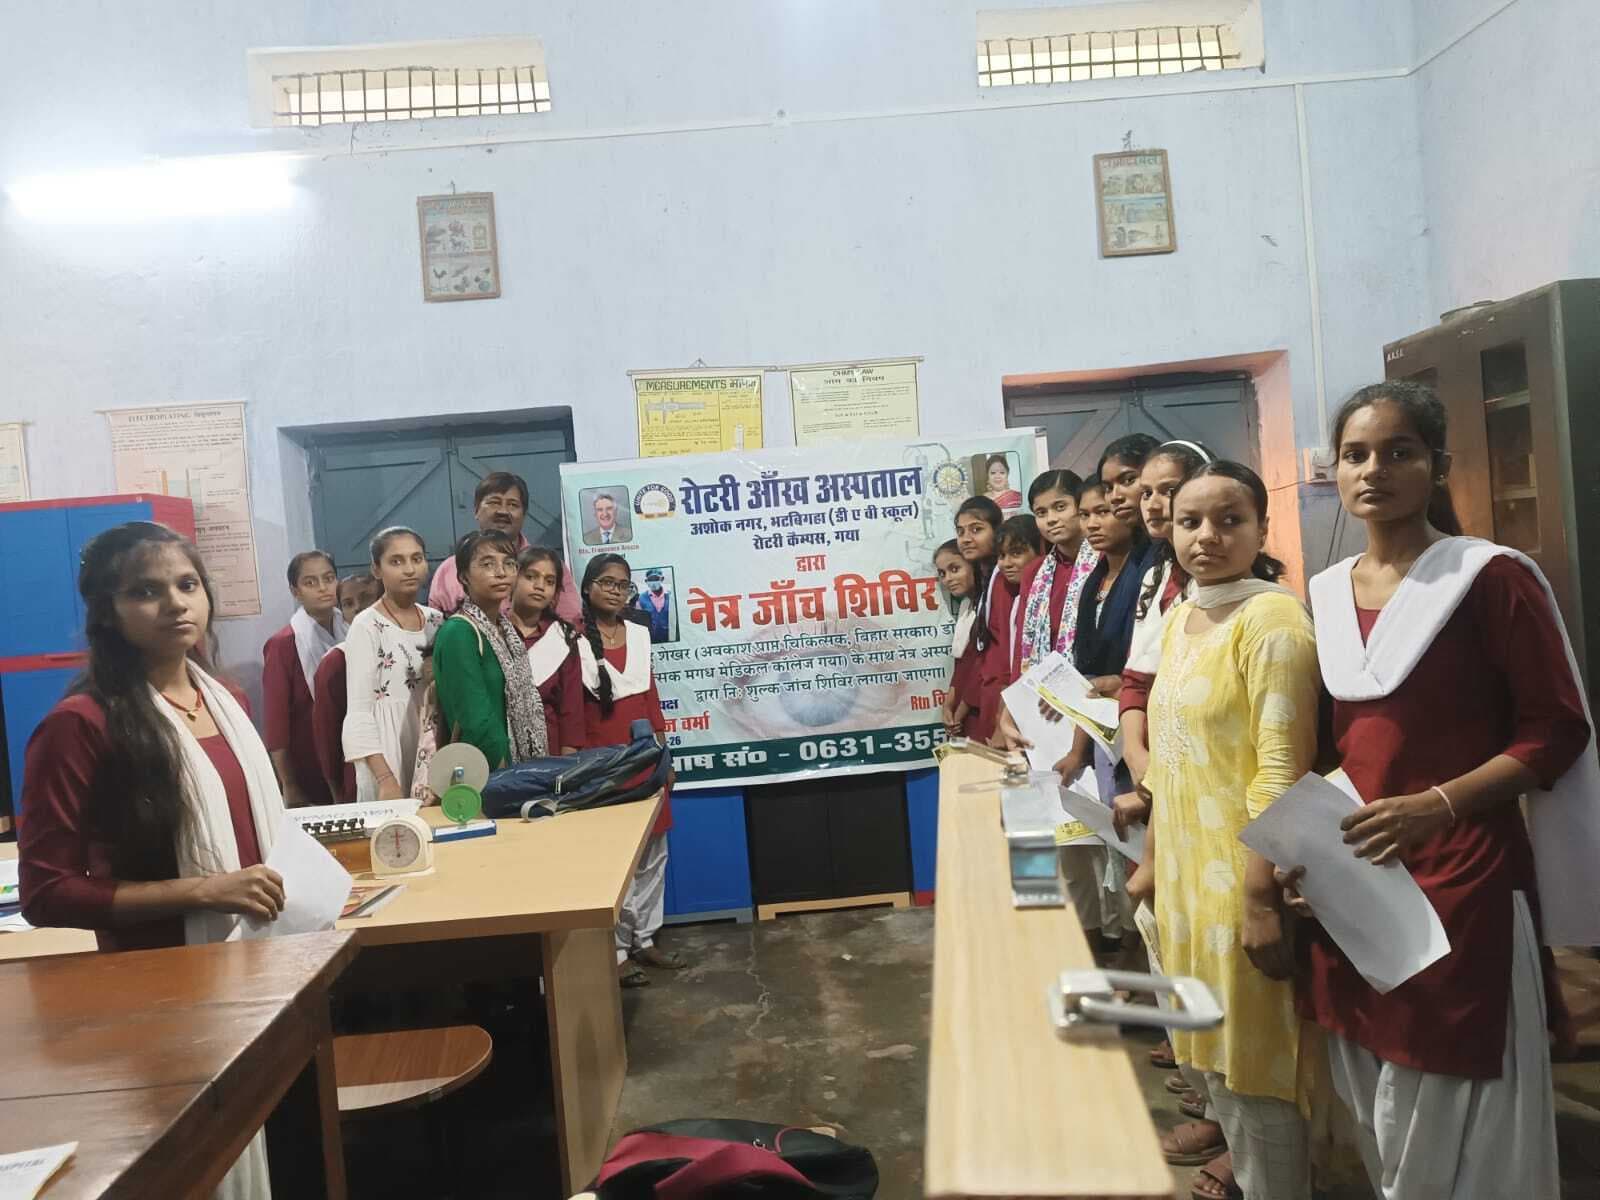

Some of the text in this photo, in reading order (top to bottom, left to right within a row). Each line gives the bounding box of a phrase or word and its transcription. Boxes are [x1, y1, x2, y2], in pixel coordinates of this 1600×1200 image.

[646, 378, 727, 391] MEASUREMENTS
[679, 474, 740, 515] रोटरी
[815, 466, 922, 504] अस्पताल
[690, 518, 732, 536] अशोक
[736, 516, 767, 532] नगर,
[828, 507, 848, 526] (डी
[852, 508, 861, 522] ए
[864, 506, 878, 521] वी
[882, 501, 919, 523] स्कूल)
[753, 532, 783, 550] रोटरी
[834, 528, 860, 544] गया
[795, 554, 827, 572] द्वारा
[687, 587, 742, 632] नेत्र
[833, 569, 940, 620] शिविर
[658, 646, 691, 663] शेखर
[694, 641, 751, 660] (अवकाश
[783, 632, 850, 651] चिकित्सक,
[855, 627, 888, 645] बिहार
[892, 623, 938, 641] सरकार)
[685, 666, 715, 681] मगध
[718, 659, 768, 678] मेडिकल
[772, 653, 814, 672] कॉलेज
[816, 655, 848, 671] गया)
[850, 650, 865, 666] के
[868, 650, 895, 665] साथ
[898, 645, 917, 661] नेत्र
[921, 645, 952, 659] अस्प
[694, 687, 719, 703] द्वारा
[746, 681, 780, 703] शुल्क
[784, 676, 812, 693] जांच
[815, 672, 854, 690] शिविर
[856, 670, 898, 686] लगाया
[681, 711, 710, 731] वर्मा
